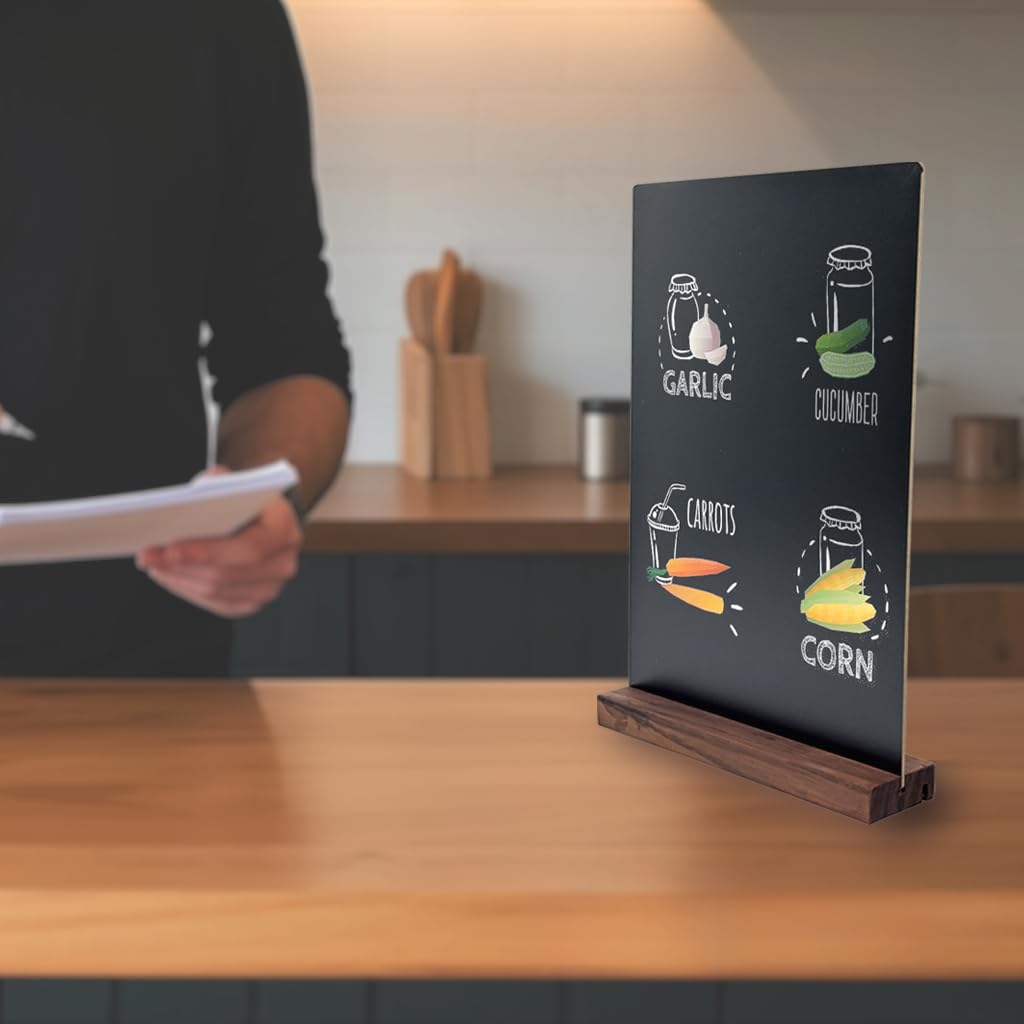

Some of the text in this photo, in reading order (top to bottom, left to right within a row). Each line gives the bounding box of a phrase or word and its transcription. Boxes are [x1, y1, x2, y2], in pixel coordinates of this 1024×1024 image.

[662, 369, 733, 401] GARLIC
[814, 387, 879, 427] CUCUMBER
[686, 497, 737, 536] CARROTS
[800, 635, 875, 683] CORN
